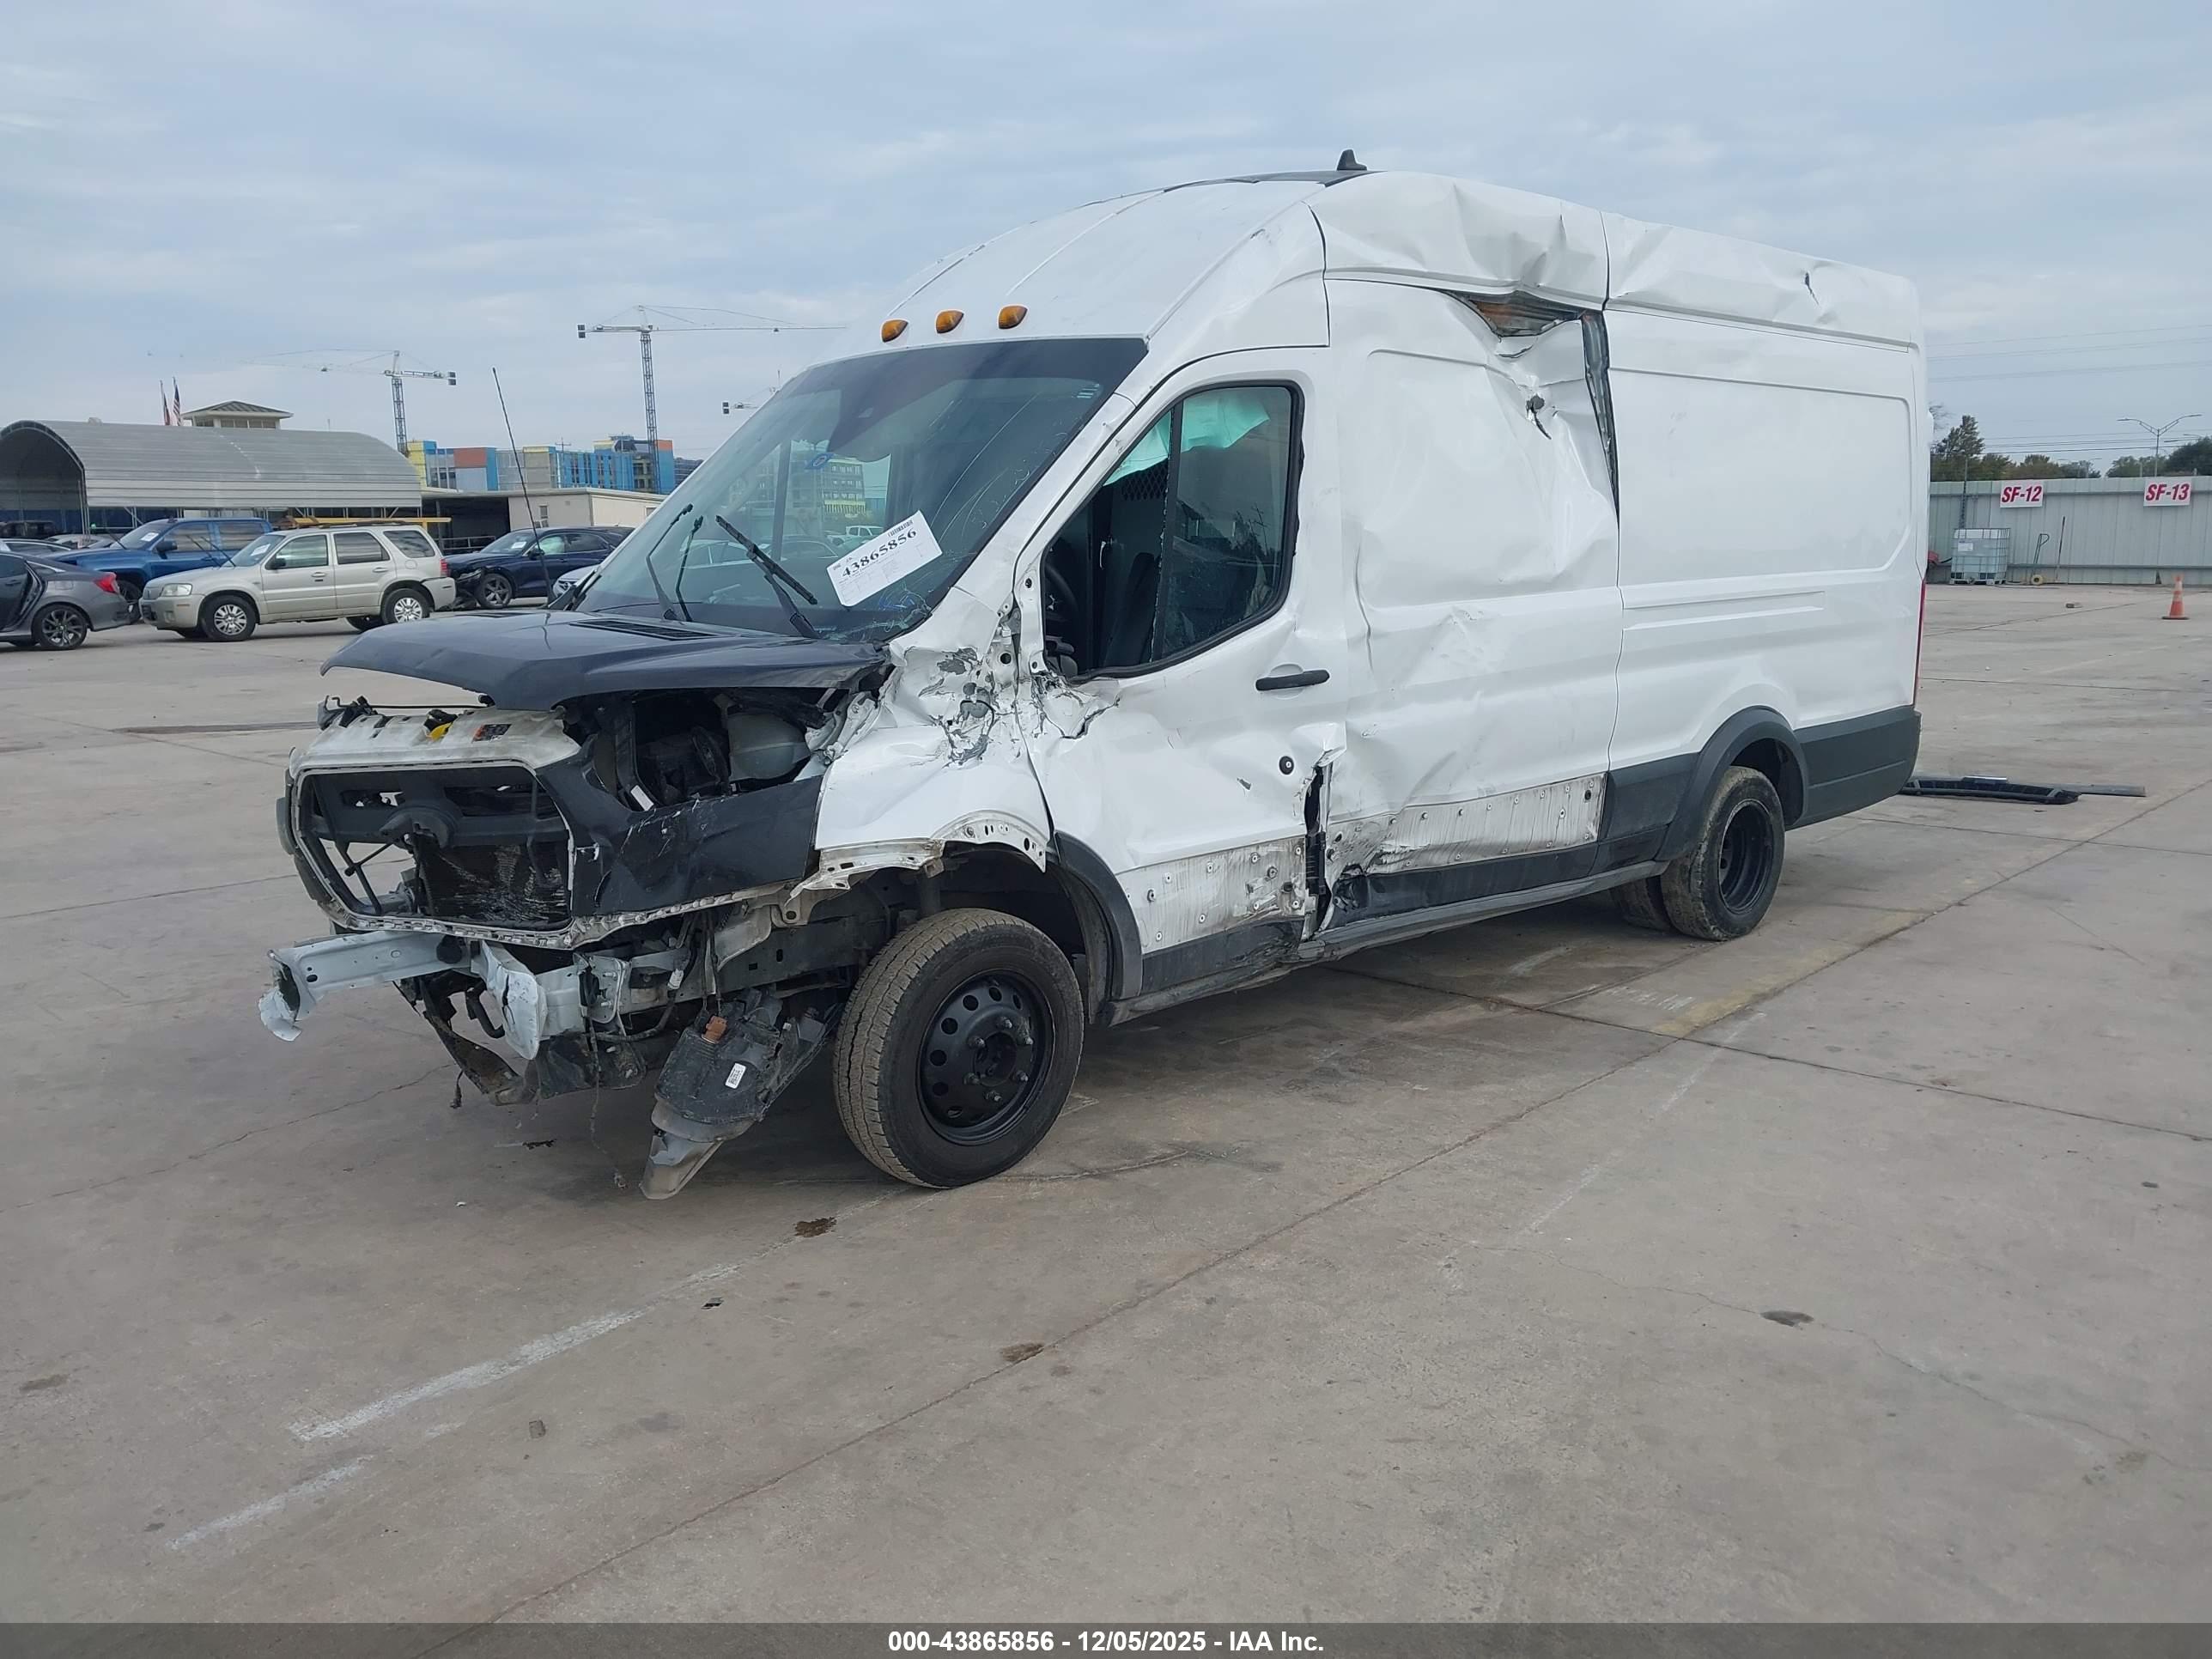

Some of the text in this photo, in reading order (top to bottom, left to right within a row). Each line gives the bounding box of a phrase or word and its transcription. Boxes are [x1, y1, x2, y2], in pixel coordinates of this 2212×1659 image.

[2001, 485, 2042, 502] SF-12
[2145, 483, 2190, 501] SF-13
[842, 528, 917, 578] 43865856
